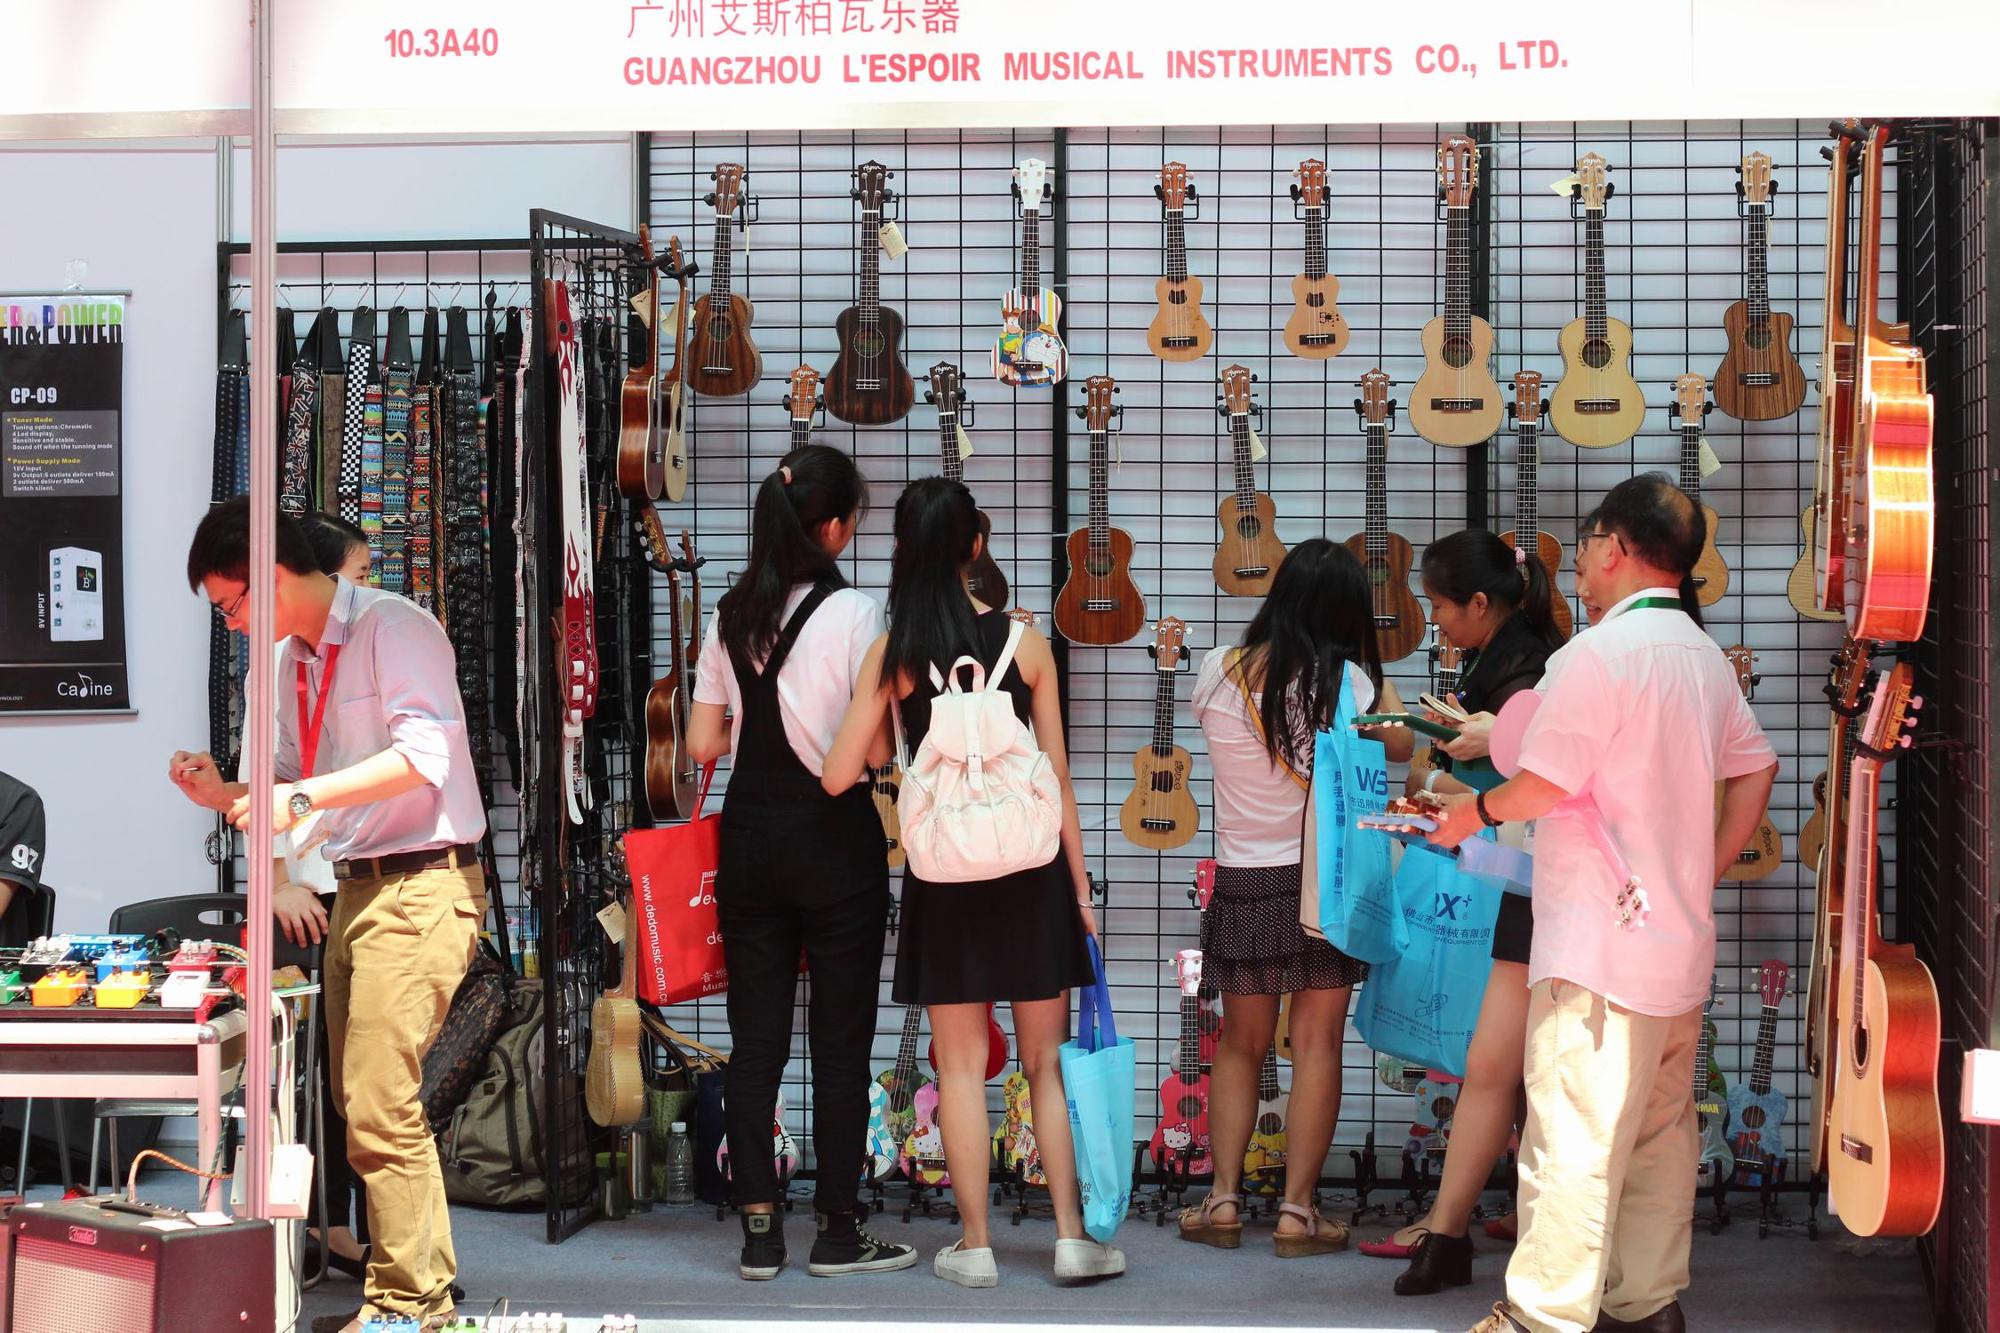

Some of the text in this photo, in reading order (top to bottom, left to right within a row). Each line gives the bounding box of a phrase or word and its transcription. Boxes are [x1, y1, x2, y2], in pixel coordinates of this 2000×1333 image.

[628, 0, 960, 37] 广州艾斯柏瓦乐器
[384, 28, 498, 57] 10.3A40
[624, 40, 1568, 85] GUANGZHOU L'ESPOIR MUSICAL INSTRUMENTS CO., LTD.
[10, 387, 57, 404] CP-09
[11, 843, 39, 874] 97
